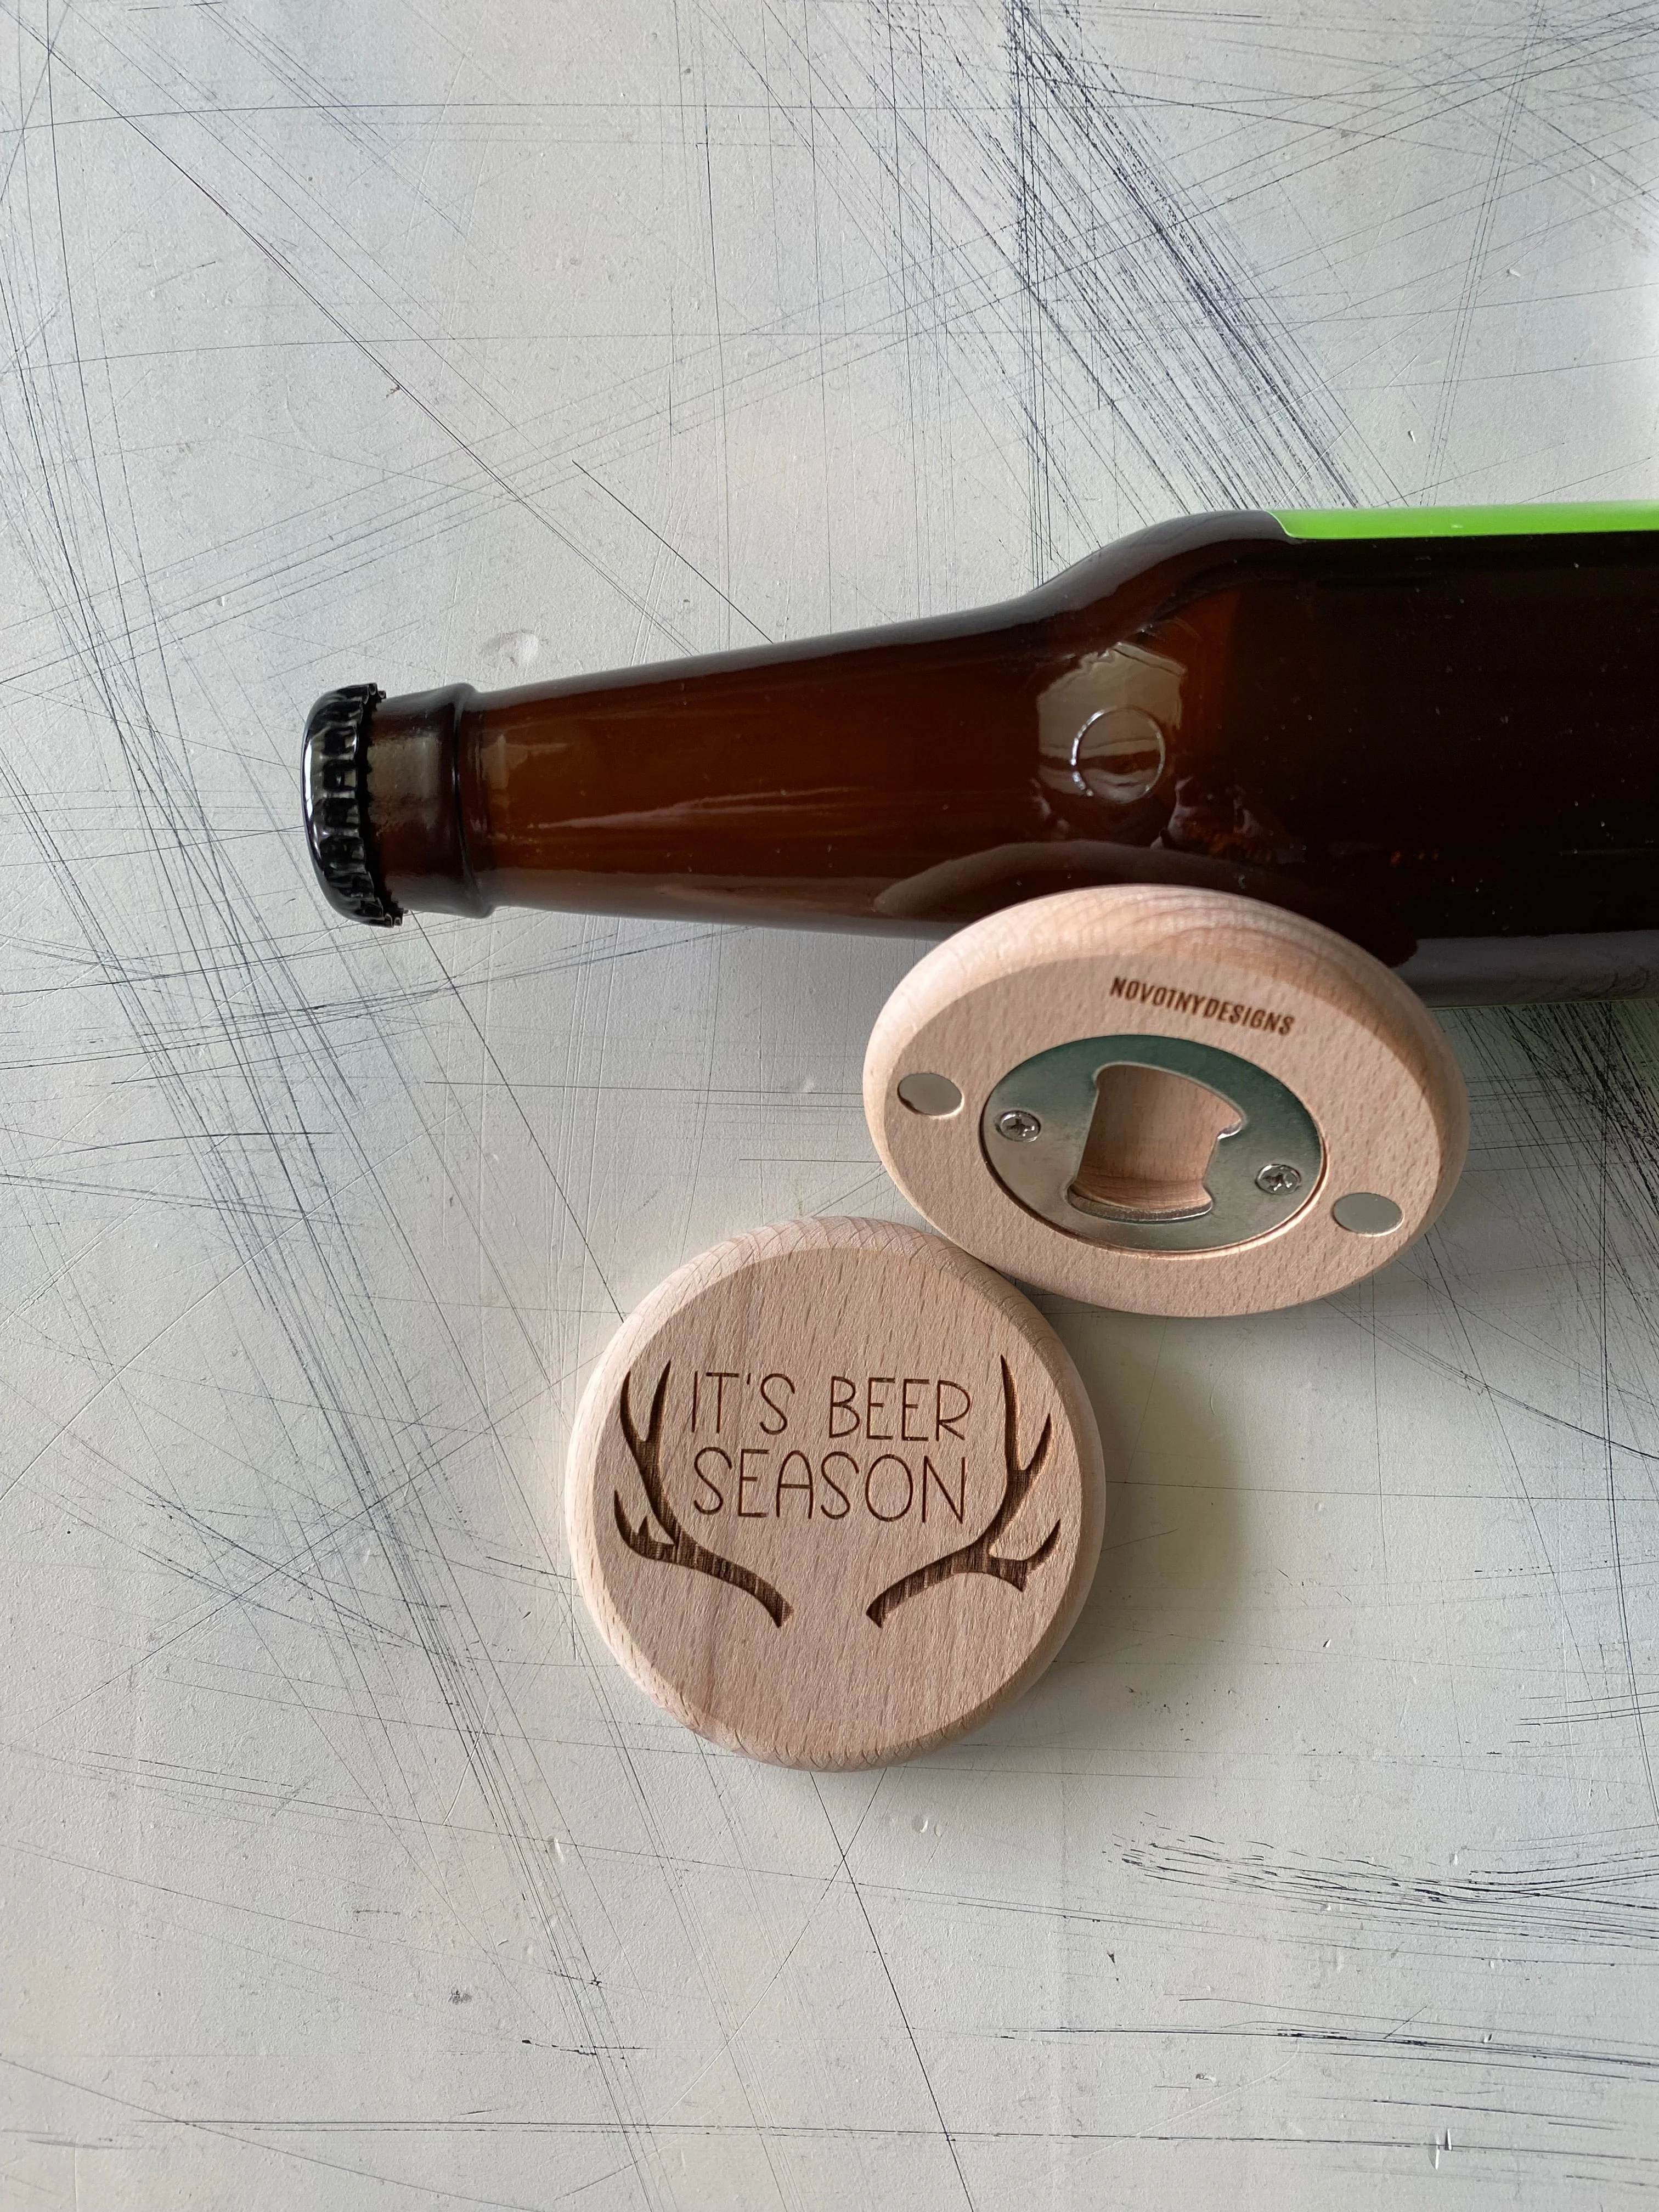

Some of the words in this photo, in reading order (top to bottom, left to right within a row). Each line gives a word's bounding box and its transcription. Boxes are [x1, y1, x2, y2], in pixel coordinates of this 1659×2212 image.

[691, 1370, 795, 1435] IT'S
[828, 1375, 971, 1442] BEER
[693, 1446, 966, 1525] SEASON
